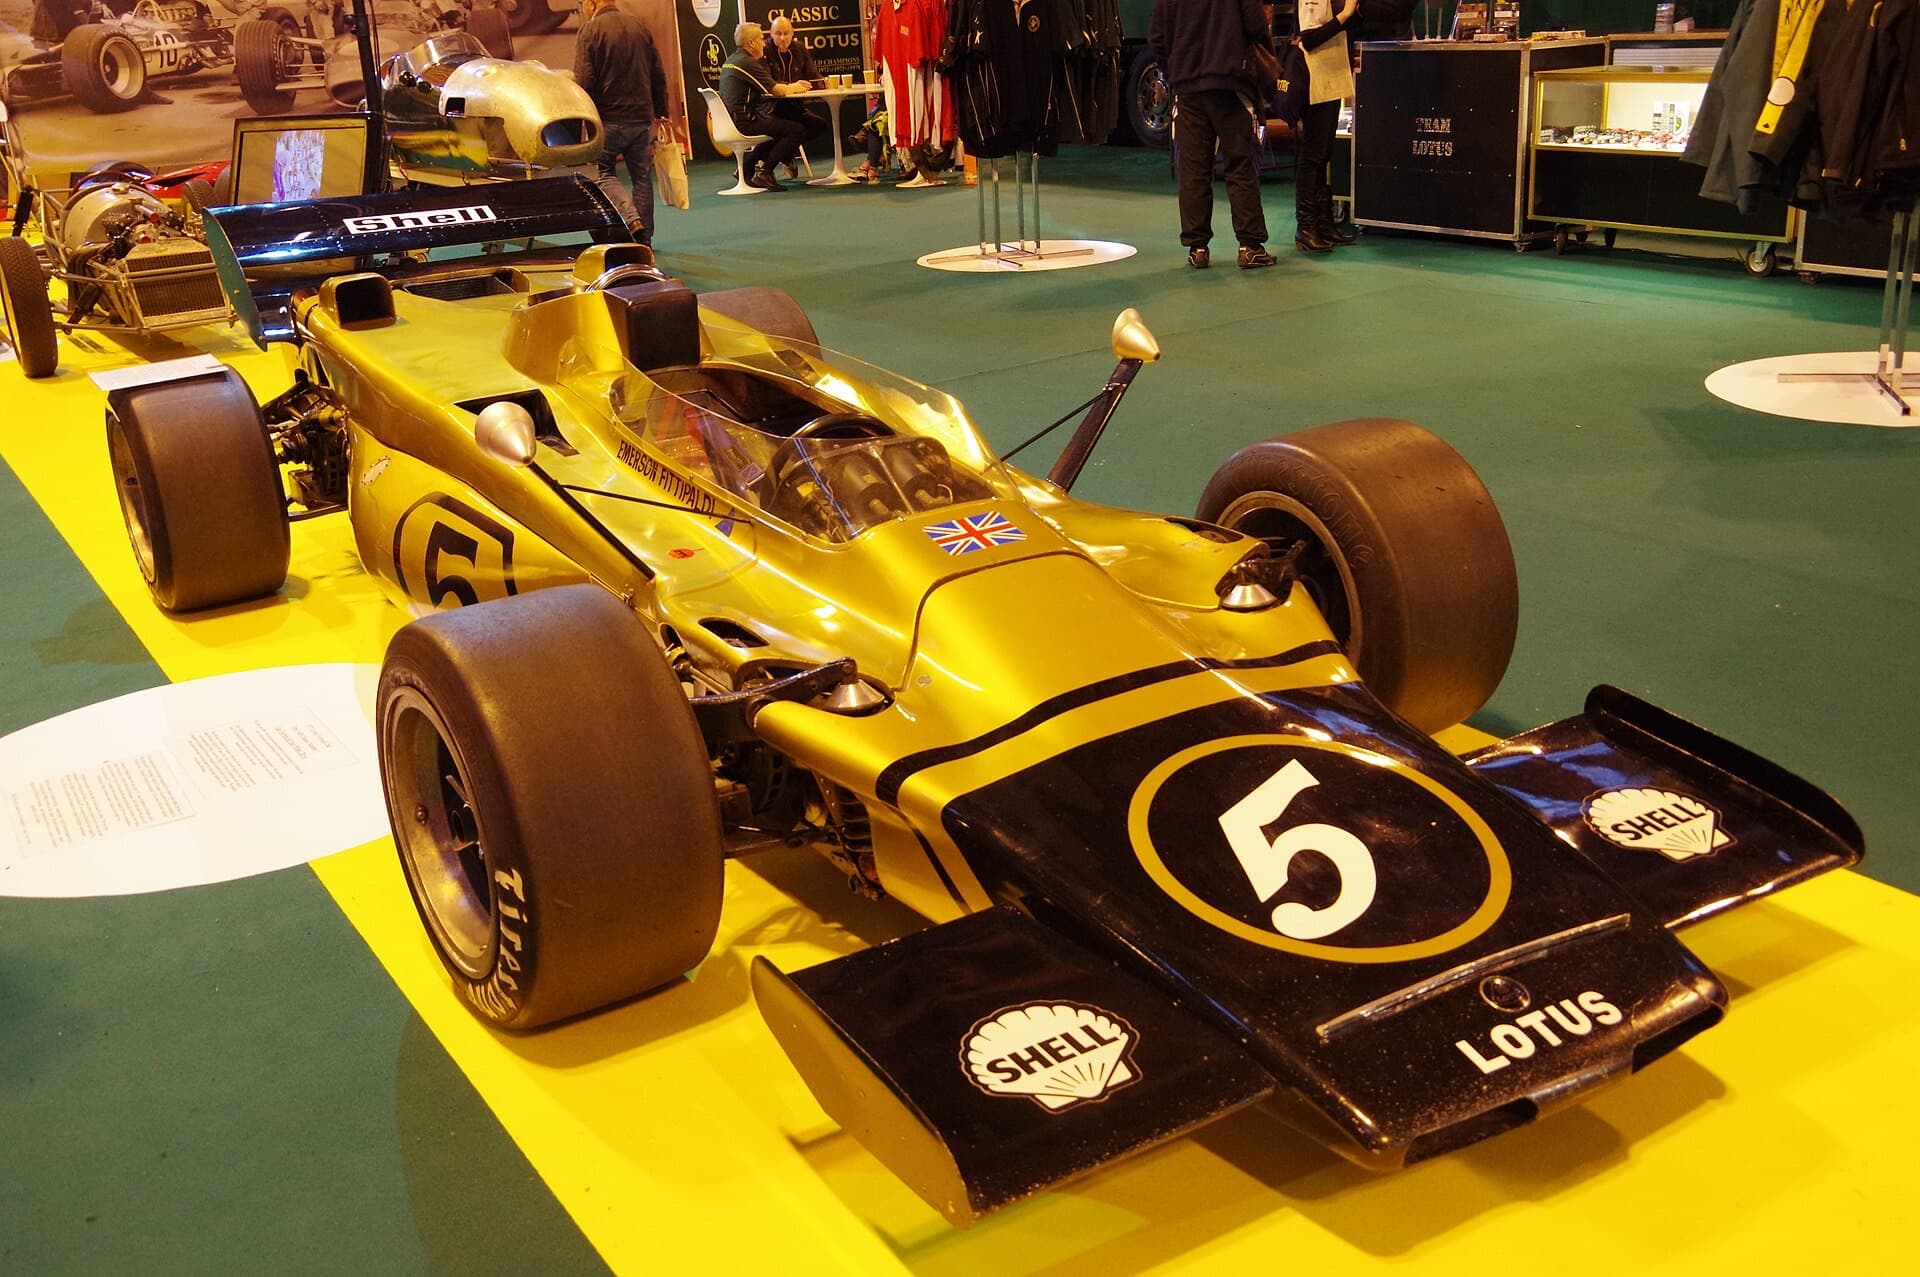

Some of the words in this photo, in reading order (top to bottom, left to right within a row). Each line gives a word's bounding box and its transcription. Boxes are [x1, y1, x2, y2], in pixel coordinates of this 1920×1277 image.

[768, 6, 839, 23] CLASSIC
[804, 33, 860, 50] LOTUS
[1415, 117, 1452, 133] TEAM
[1411, 140, 1453, 157] LOTUS
[352, 207, 489, 232] Shell
[616, 439, 659, 482] EMERSON
[658, 467, 716, 518] FITTIPALDI
[424, 520, 480, 608] 5
[1610, 802, 1707, 842] SHELL
[1217, 757, 1378, 940] 5
[1454, 990, 1623, 1075] LOTUS
[986, 1024, 1121, 1084] SHELL
